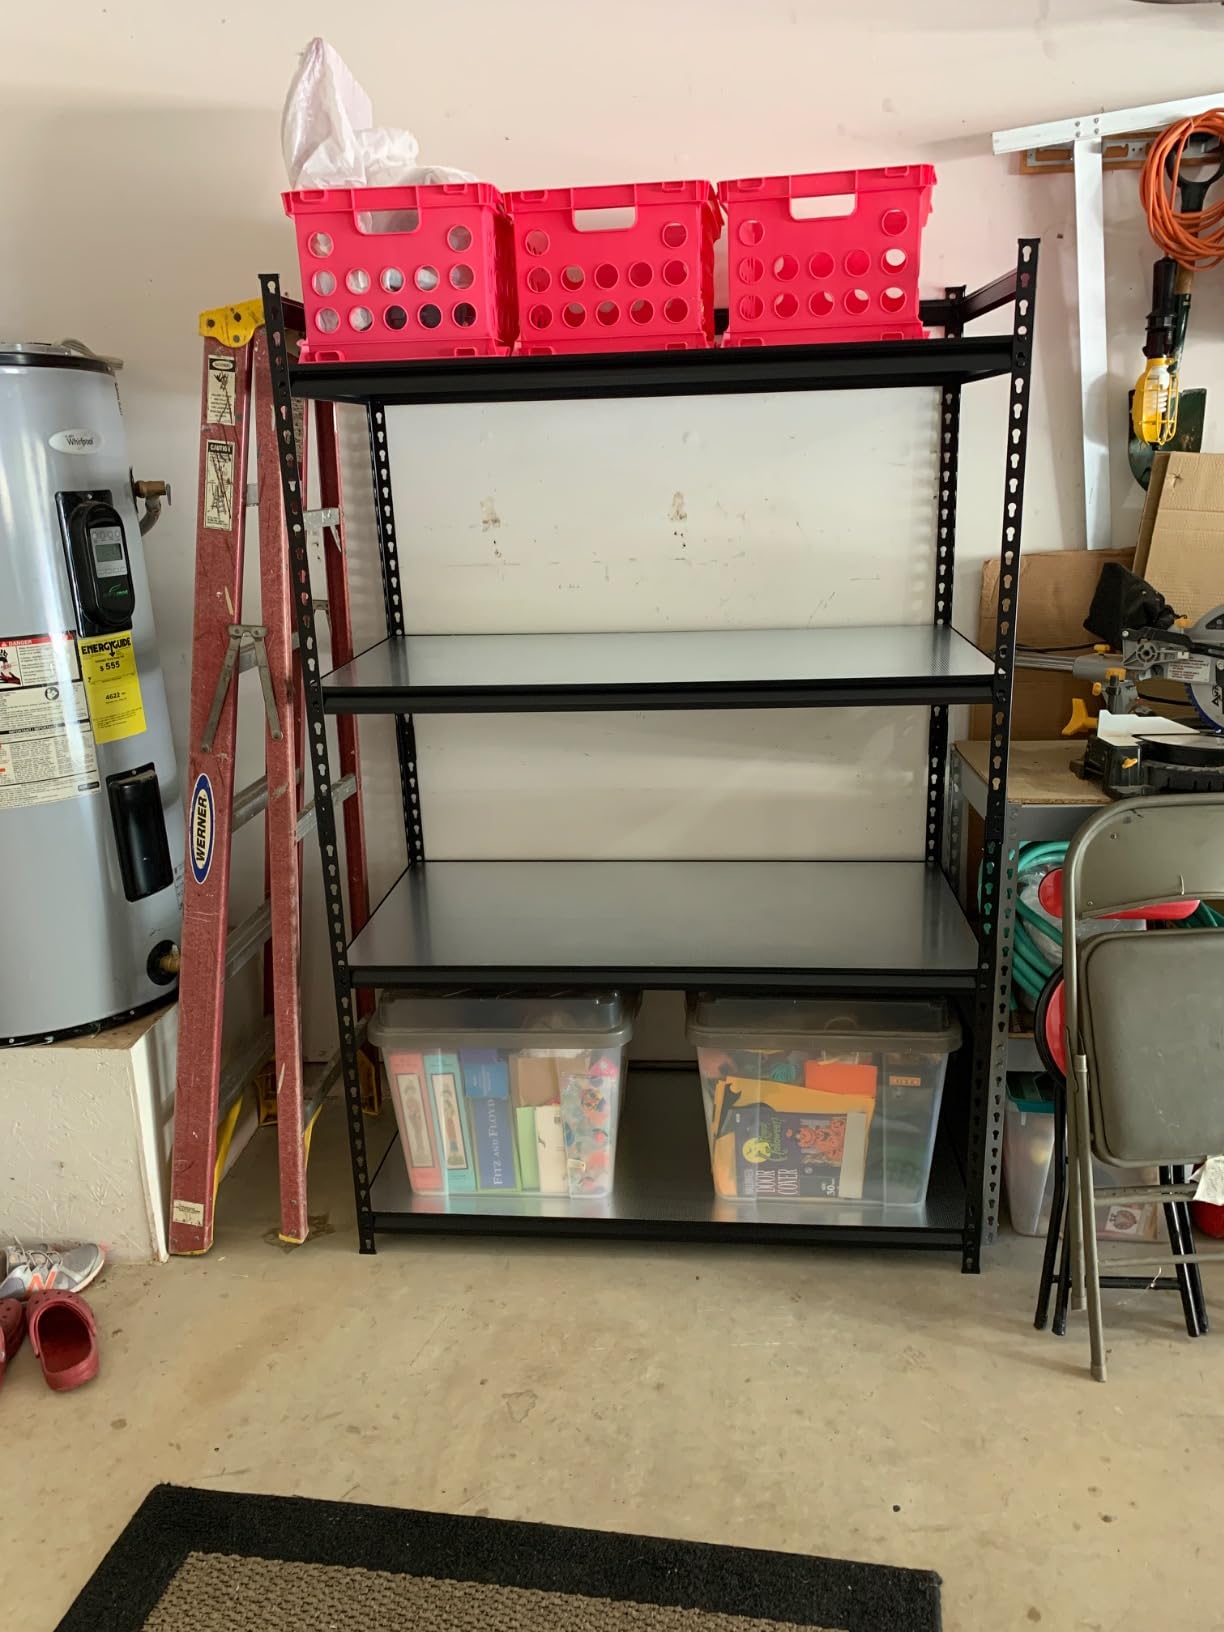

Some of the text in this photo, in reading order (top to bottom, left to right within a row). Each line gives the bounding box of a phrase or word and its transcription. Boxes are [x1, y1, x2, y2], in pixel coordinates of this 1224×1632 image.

[105, 661, 120, 671] 555
[196, 795, 208, 861] WERNER
[487, 1098, 499, 1137] FLOYD
[492, 1160, 504, 1185] FITZ
[755, 1170, 776, 1193] DOOR
[777, 1168, 798, 1195] COVER
